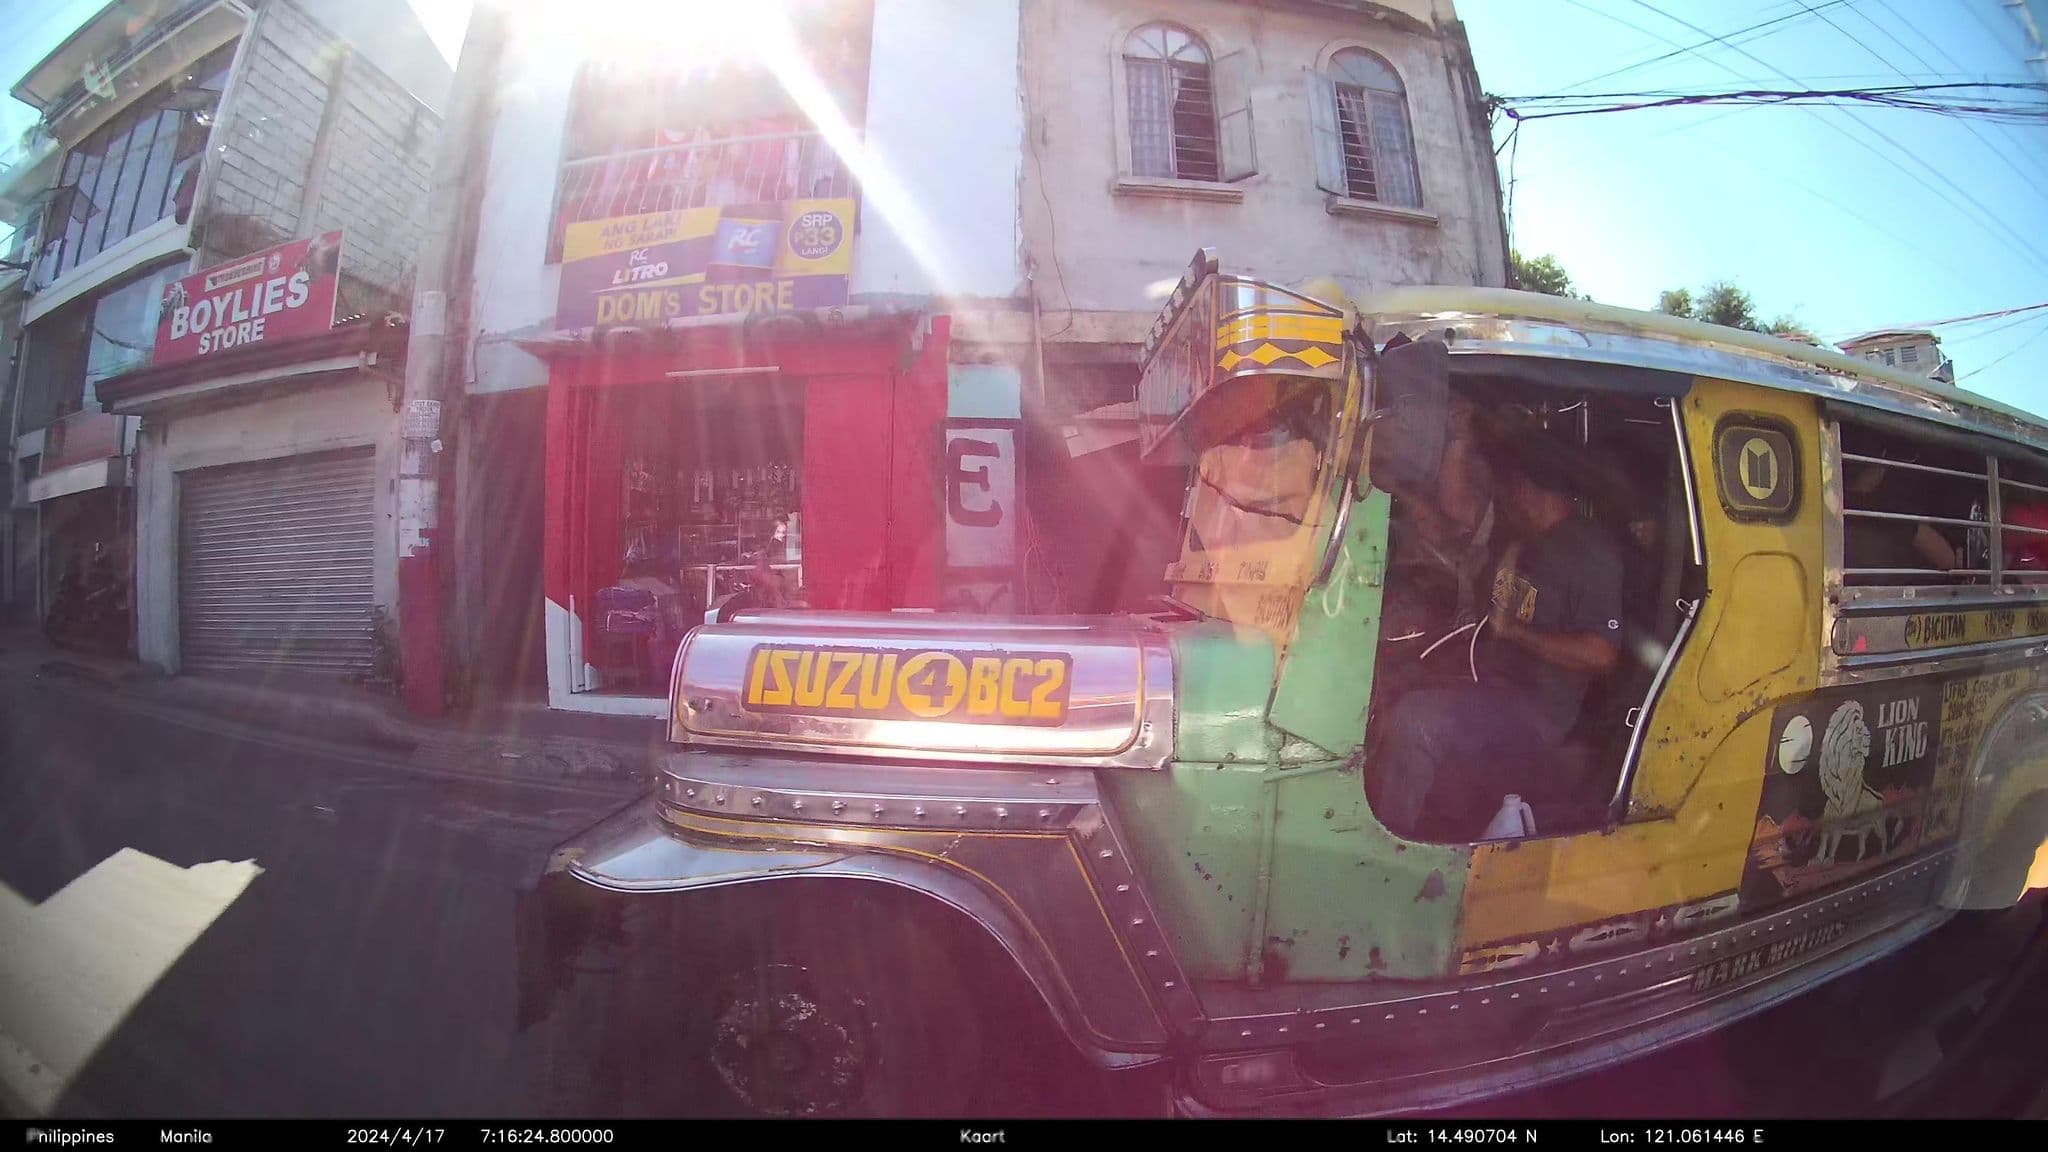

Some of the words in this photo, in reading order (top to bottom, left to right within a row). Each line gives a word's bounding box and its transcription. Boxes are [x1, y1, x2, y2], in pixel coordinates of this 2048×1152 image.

[800, 213, 833, 228] SRP
[612, 261, 669, 284] LITRO
[629, 248, 649, 266] RC
[170, 271, 310, 340] BOYLIES
[698, 279, 795, 315] STORE
[198, 317, 266, 354] STORE
[1878, 697, 1920, 728] LION
[1881, 721, 1928, 768] KING
